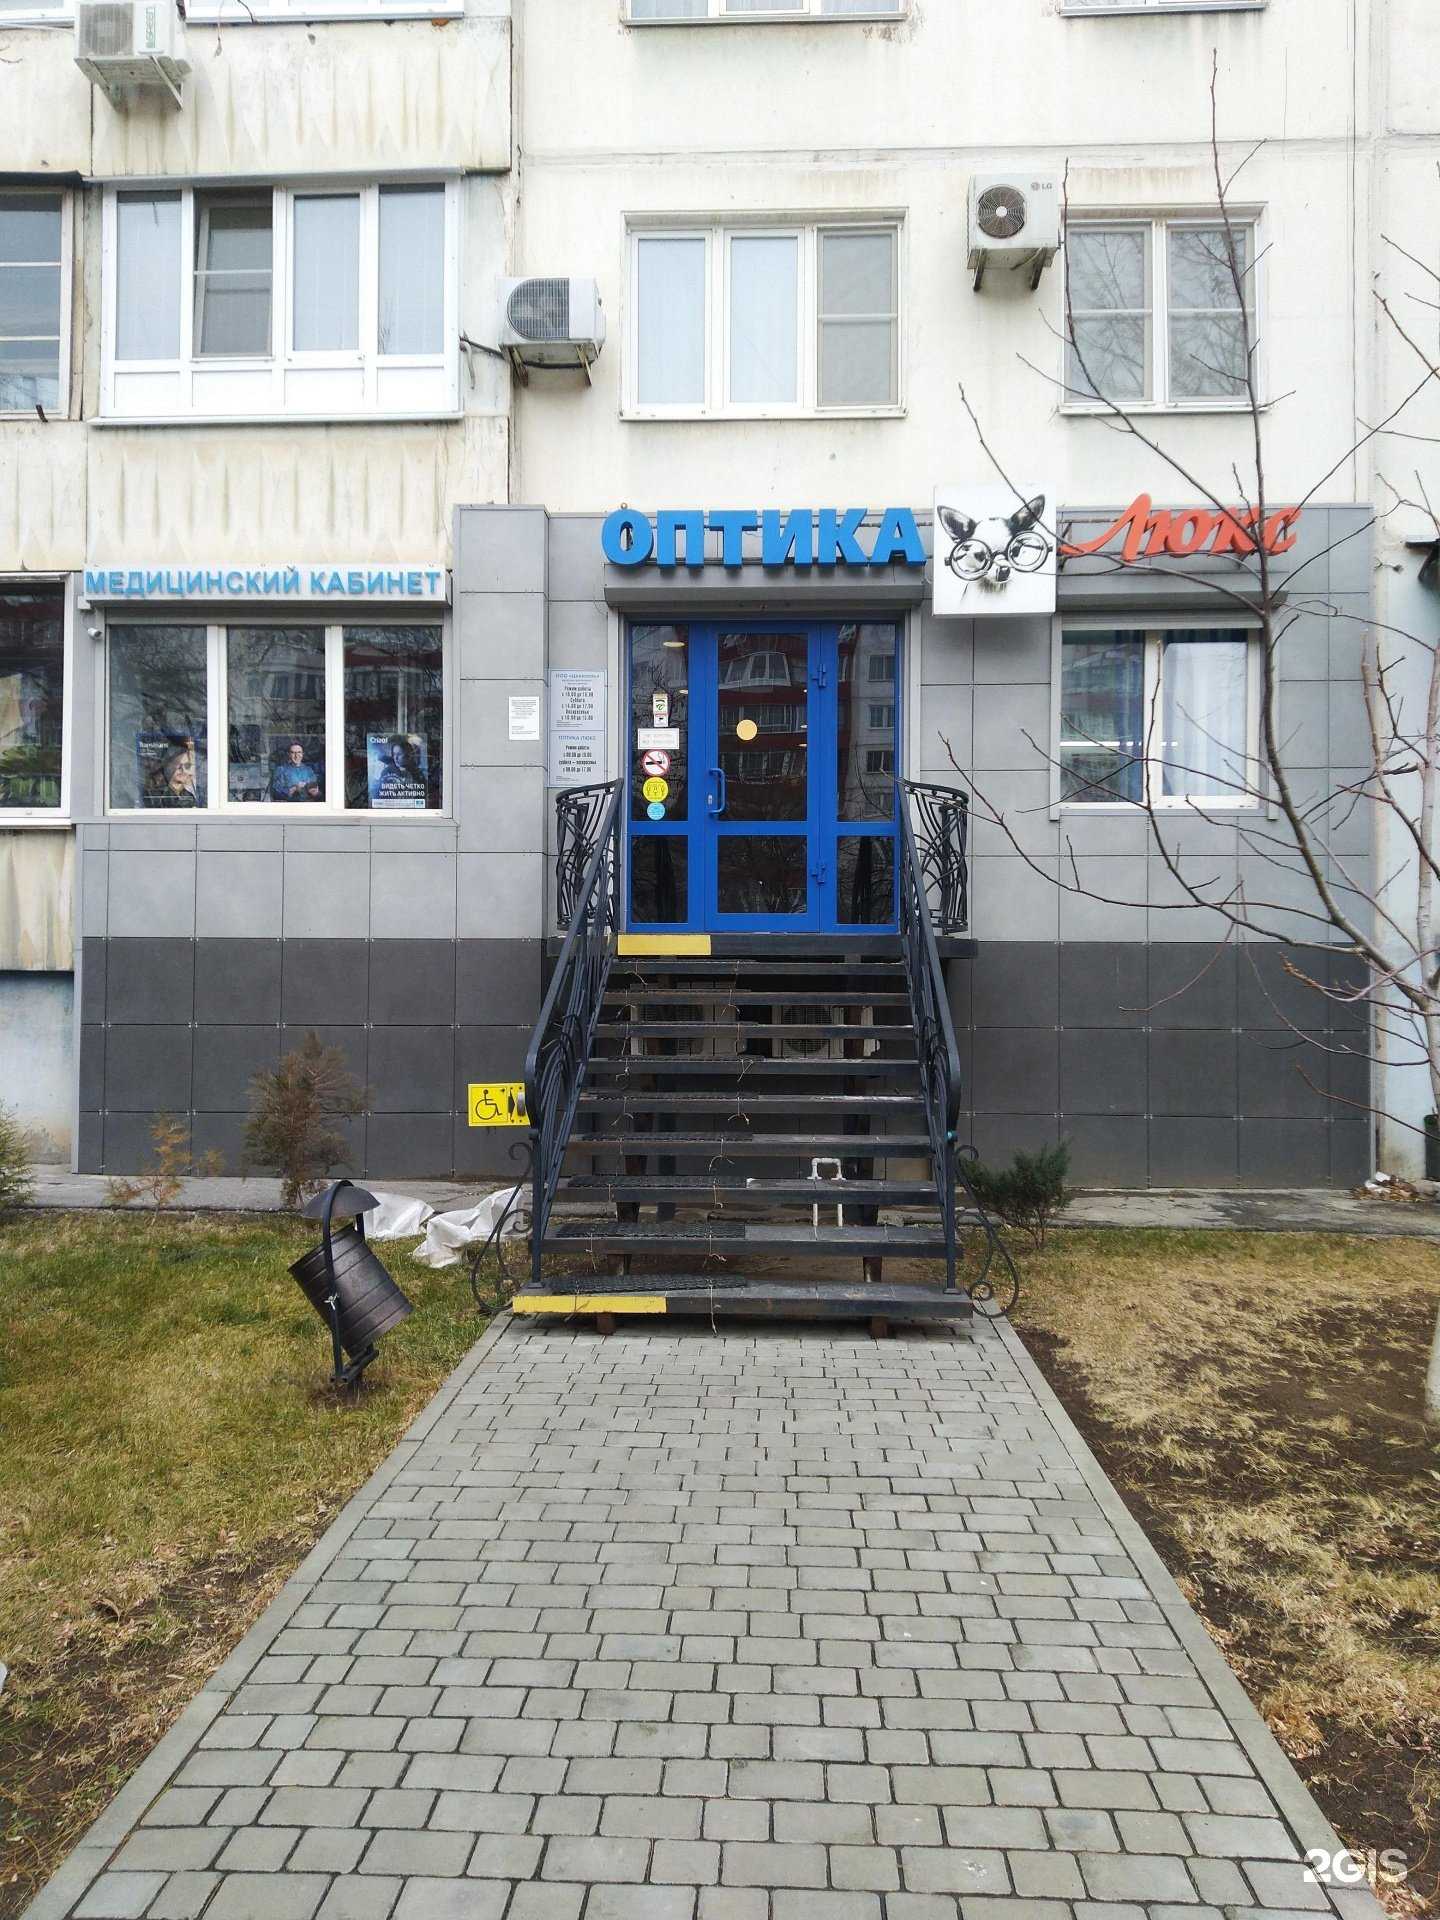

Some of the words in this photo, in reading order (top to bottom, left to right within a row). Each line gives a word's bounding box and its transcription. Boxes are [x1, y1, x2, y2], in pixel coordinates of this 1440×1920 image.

[1041, 182, 1053, 190] LG
[601, 507, 927, 568] ОПТИКА
[84, 568, 300, 598] МЕДИЦИНСКИЙ
[310, 570, 441, 596] КАБИНЕТ
